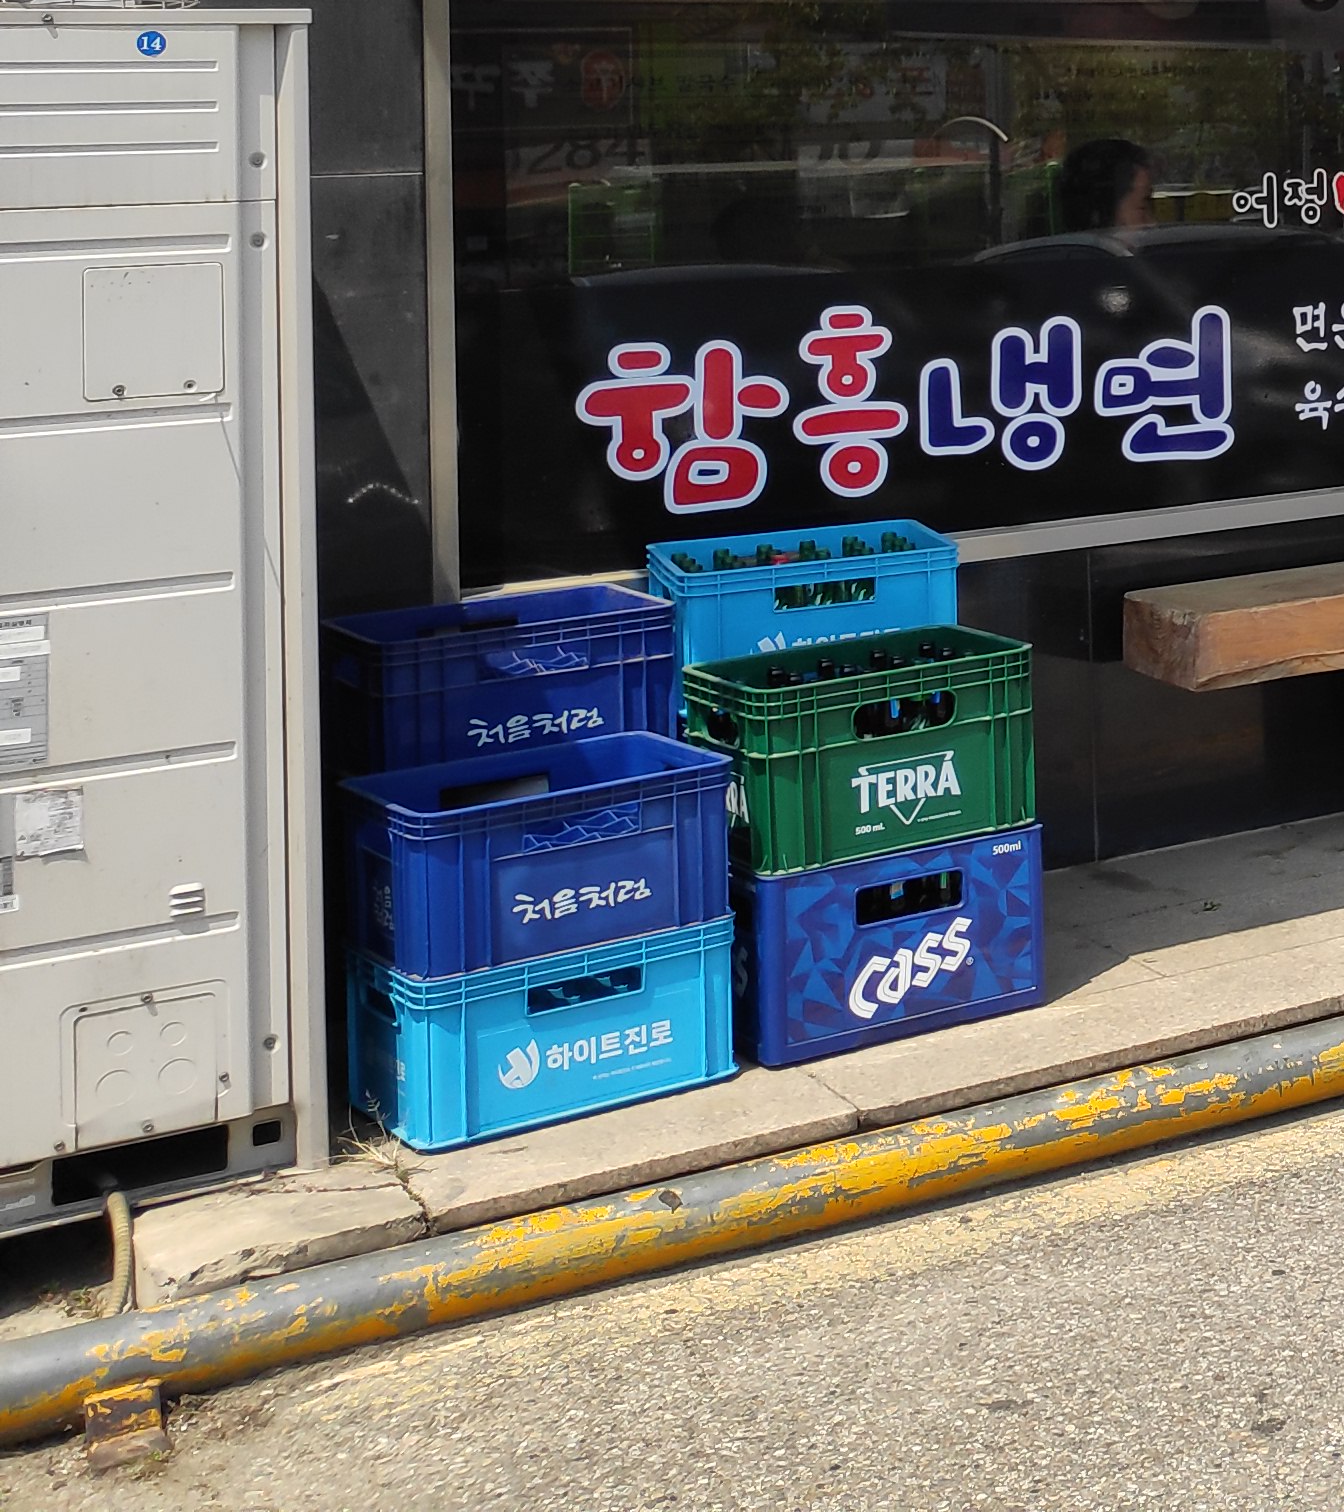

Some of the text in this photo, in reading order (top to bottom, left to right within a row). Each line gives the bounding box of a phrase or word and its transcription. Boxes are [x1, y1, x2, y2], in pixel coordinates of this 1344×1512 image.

[140, 36, 163, 51] 14
[1232, 168, 1327, 228] 어정
[576, 305, 1235, 516] 함흥냉면
[467, 706, 605, 748] 처음처럼
[851, 758, 962, 814] TERRA
[992, 840, 1022, 856] 500ml
[512, 878, 652, 924] 처음처럼
[546, 1019, 674, 1071] 하이트진로
